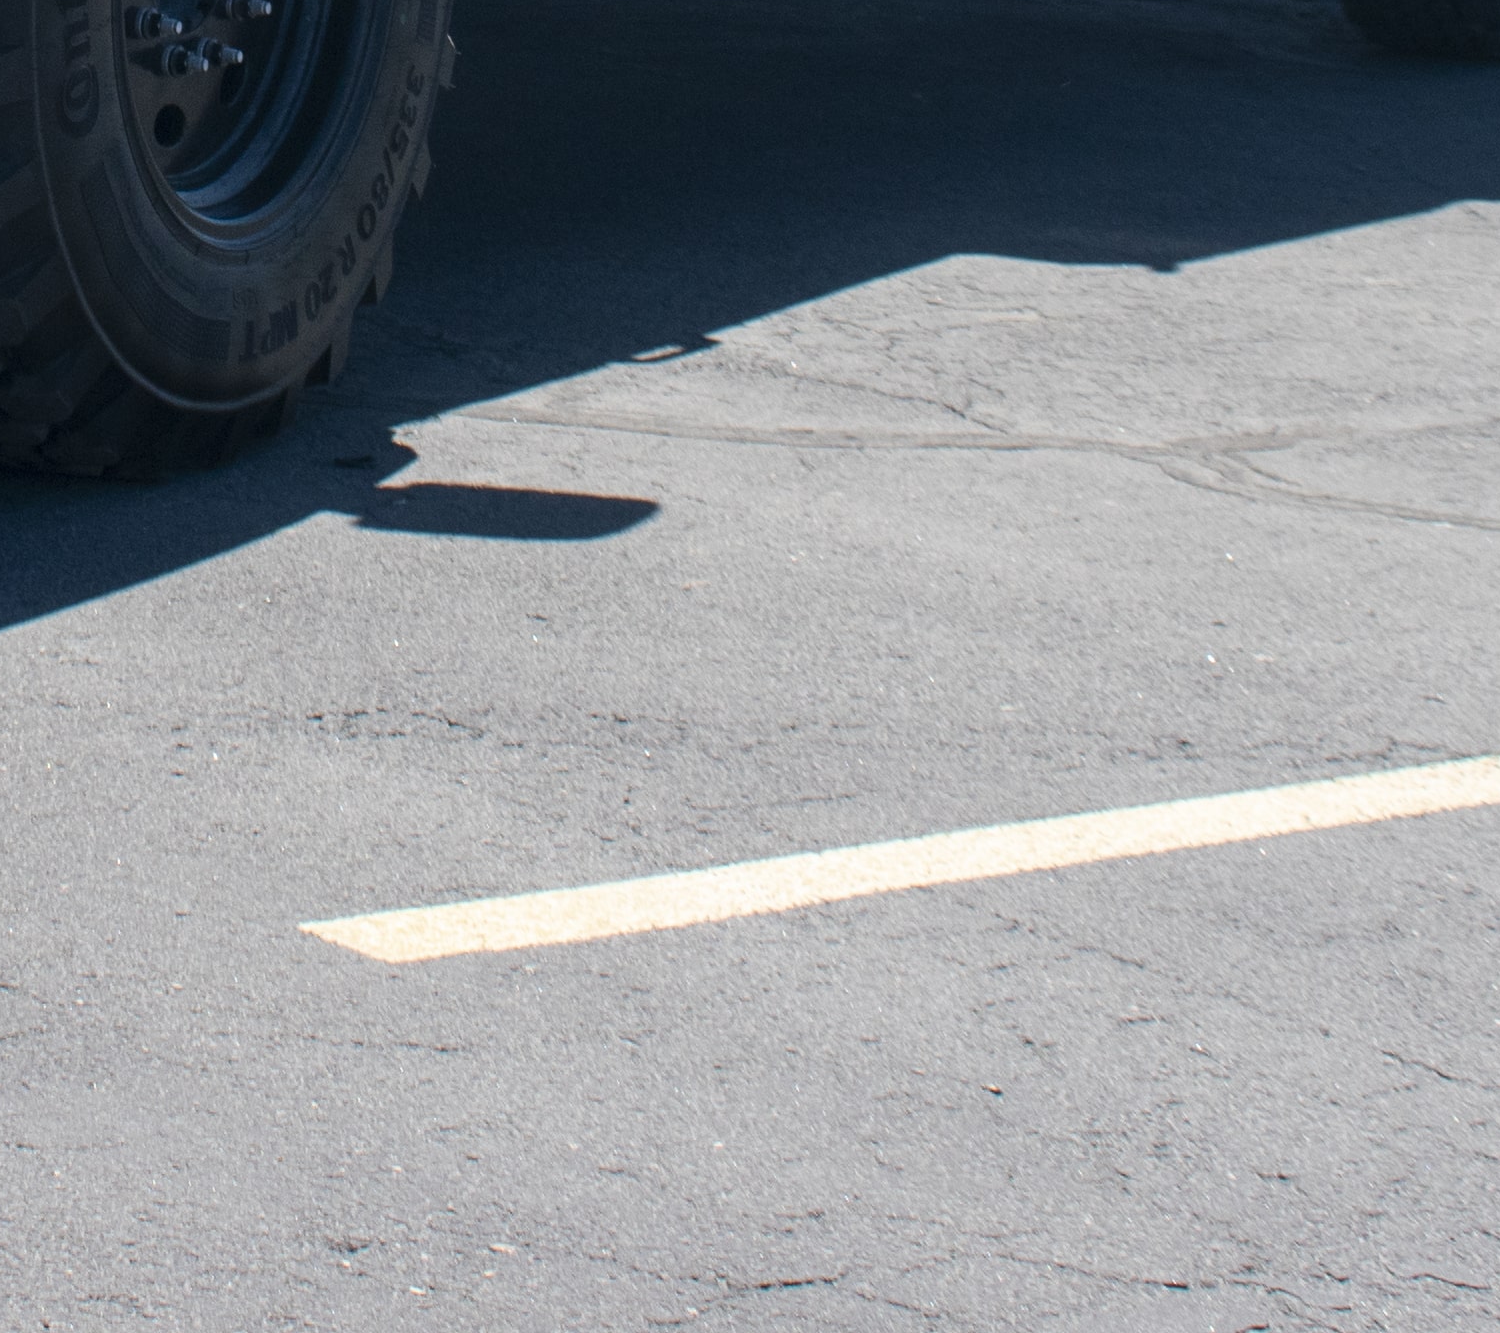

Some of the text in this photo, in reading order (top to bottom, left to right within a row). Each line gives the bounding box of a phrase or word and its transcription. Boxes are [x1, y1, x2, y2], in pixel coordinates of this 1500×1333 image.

[356, 64, 425, 241] 335/80
[336, 233, 356, 276] R
[304, 260, 337, 322] 20
